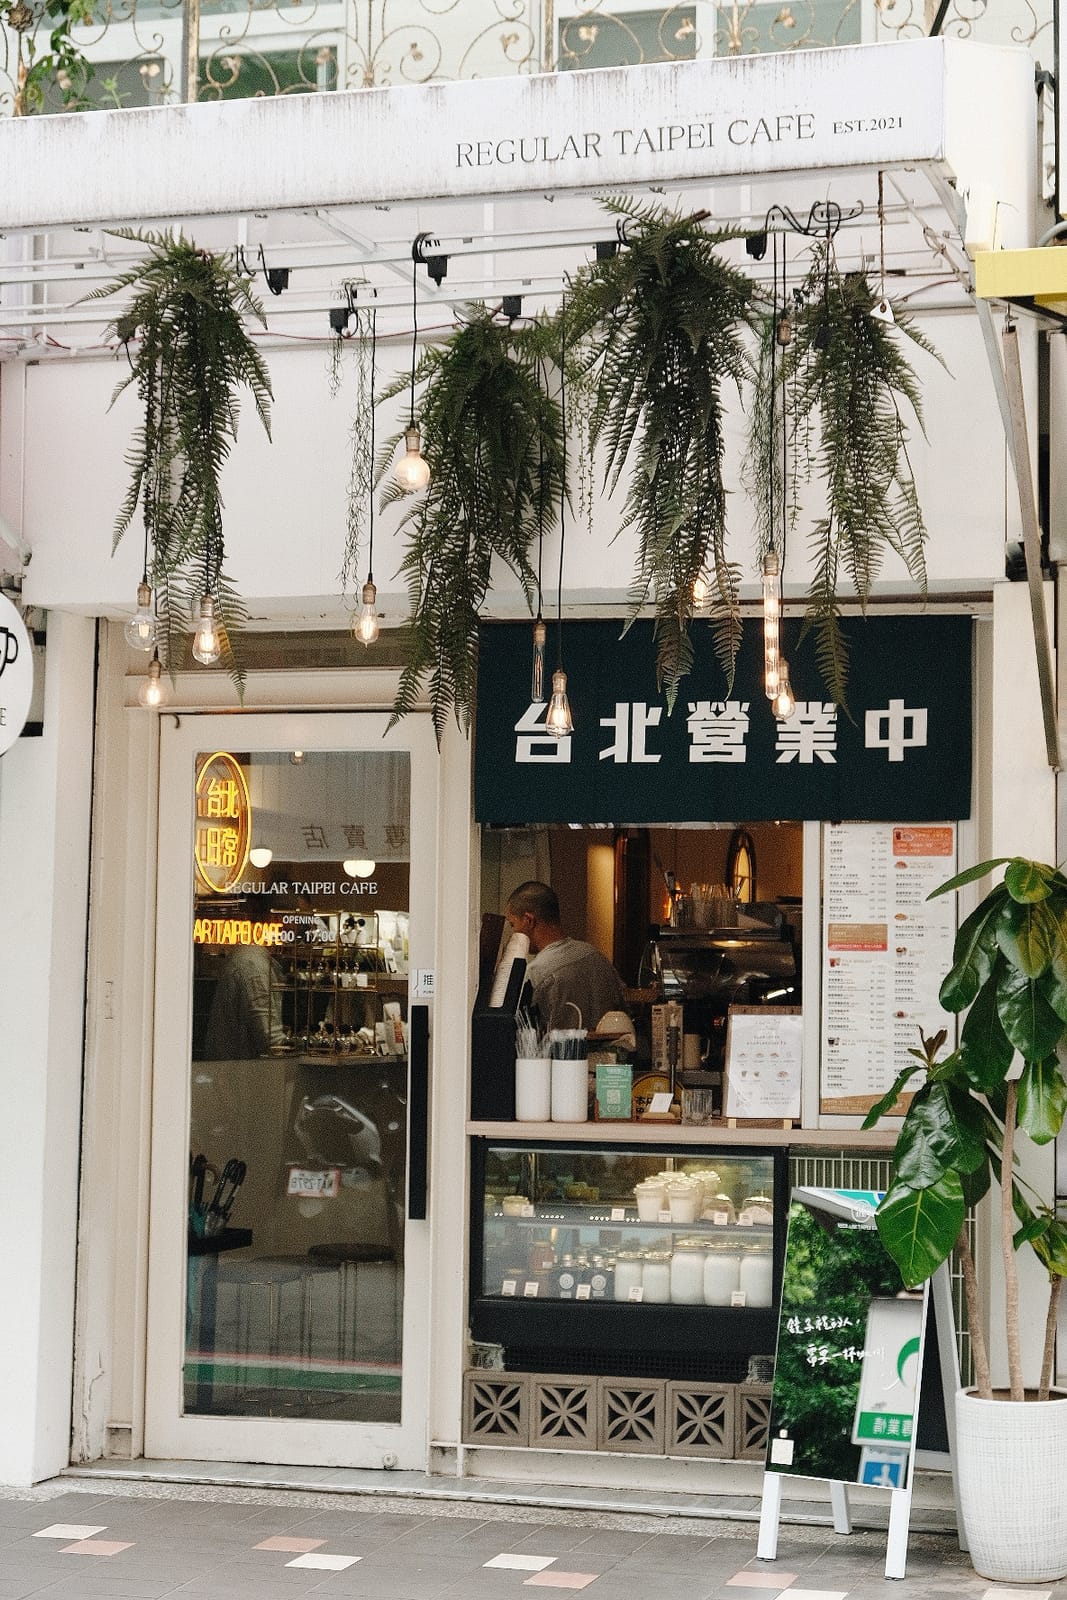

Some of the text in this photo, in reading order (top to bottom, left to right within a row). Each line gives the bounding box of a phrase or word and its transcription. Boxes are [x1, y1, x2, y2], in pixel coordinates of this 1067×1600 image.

[455, 113, 904, 168] REGULAR TAIPEI CAFE EST.2021
[513, 699, 928, 764] 台北營業中
[291, 882, 336, 895] TAIPEI
[339, 882, 378, 895] CAFE
